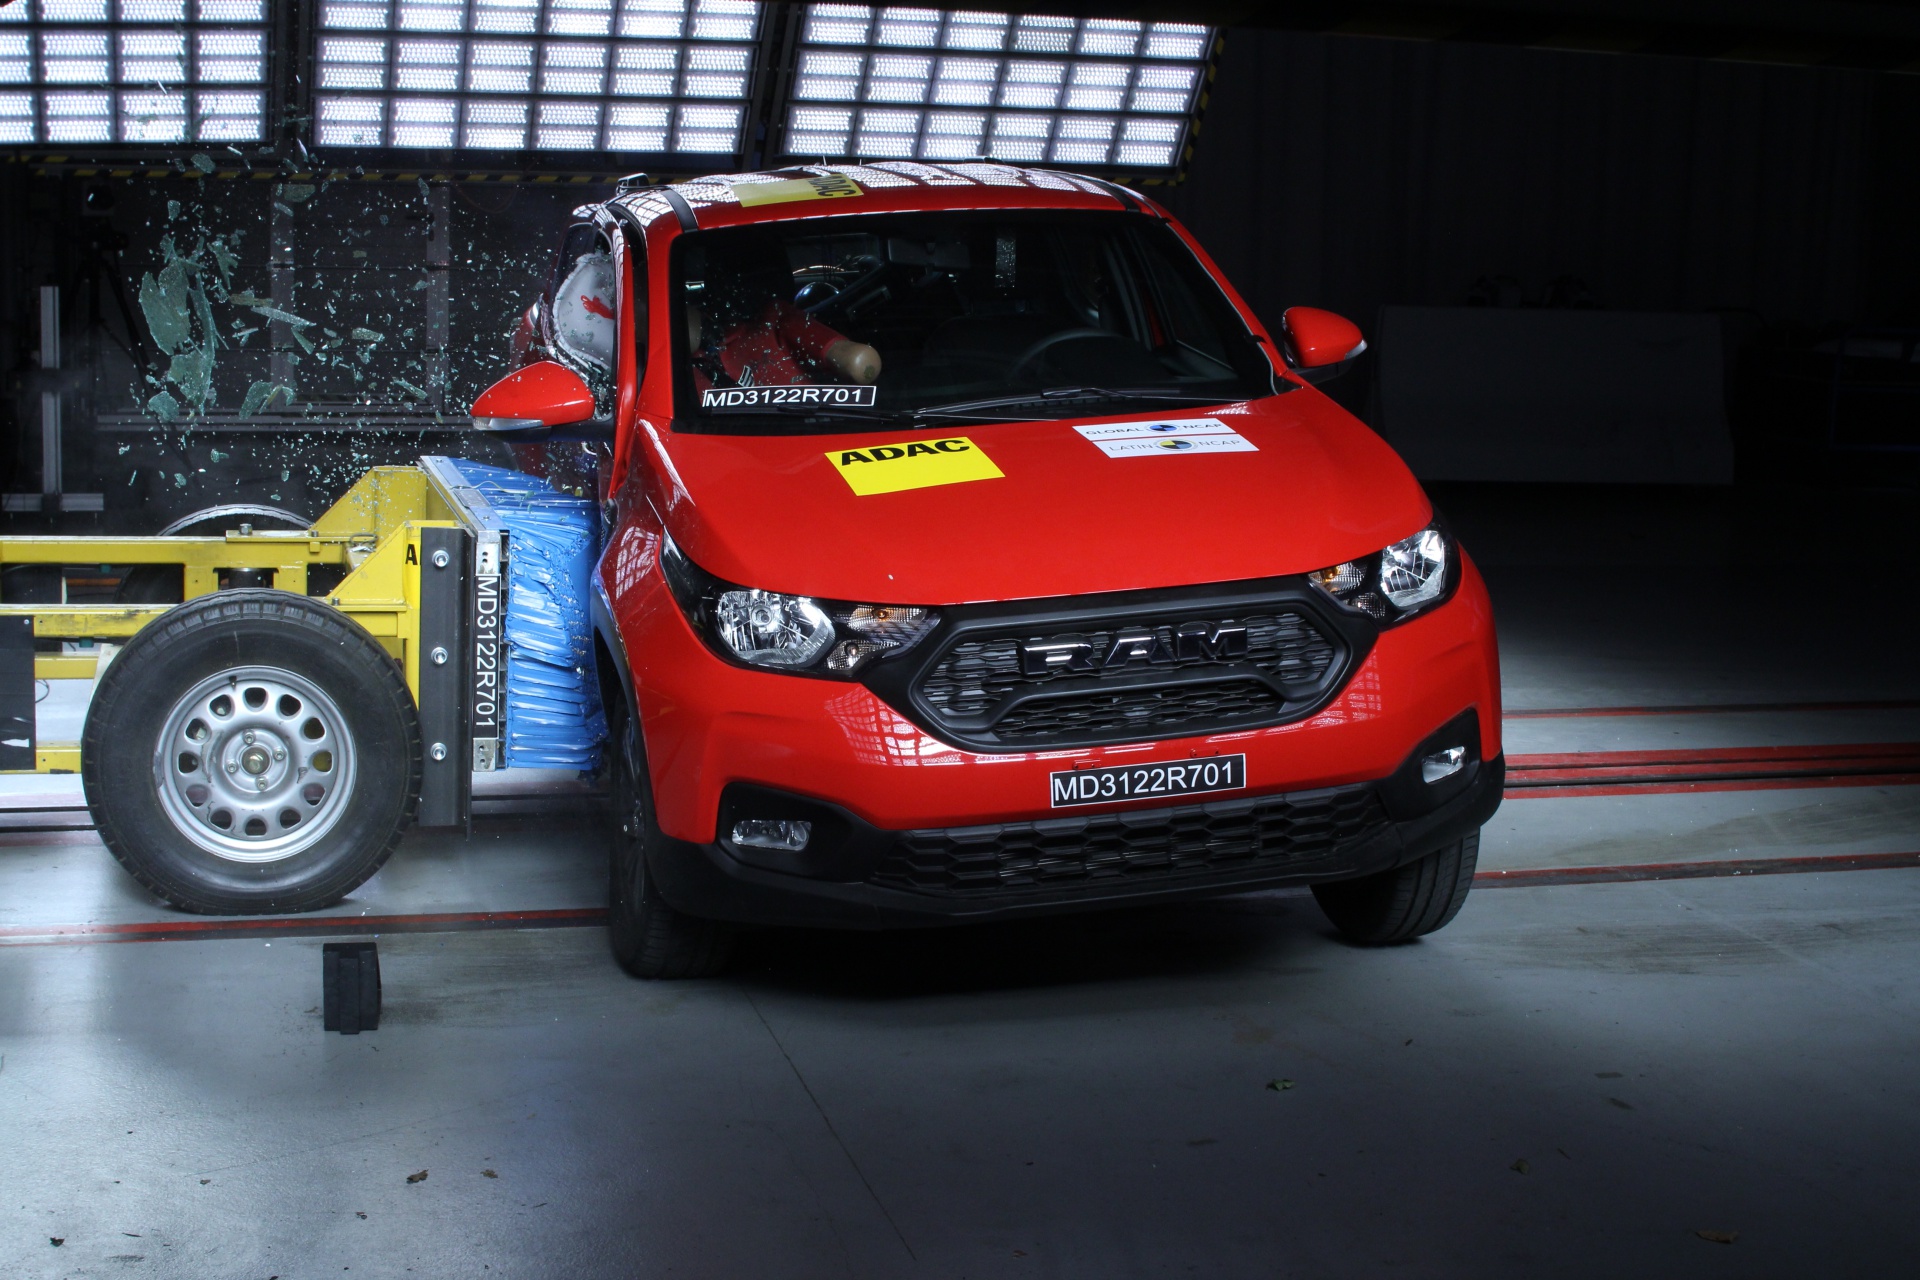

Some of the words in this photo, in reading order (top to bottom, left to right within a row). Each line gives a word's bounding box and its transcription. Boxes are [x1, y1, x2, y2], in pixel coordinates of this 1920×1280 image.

[705, 388, 862, 407] MD3122R701
[1085, 427, 1143, 435] GLOBAL
[841, 439, 970, 466] ADAC
[1109, 443, 1152, 451] LATIN
[405, 543, 418, 566] A
[475, 576, 498, 727] MD3122R701
[1024, 627, 1248, 675] RAM
[1054, 761, 1232, 801] MD3122R701
